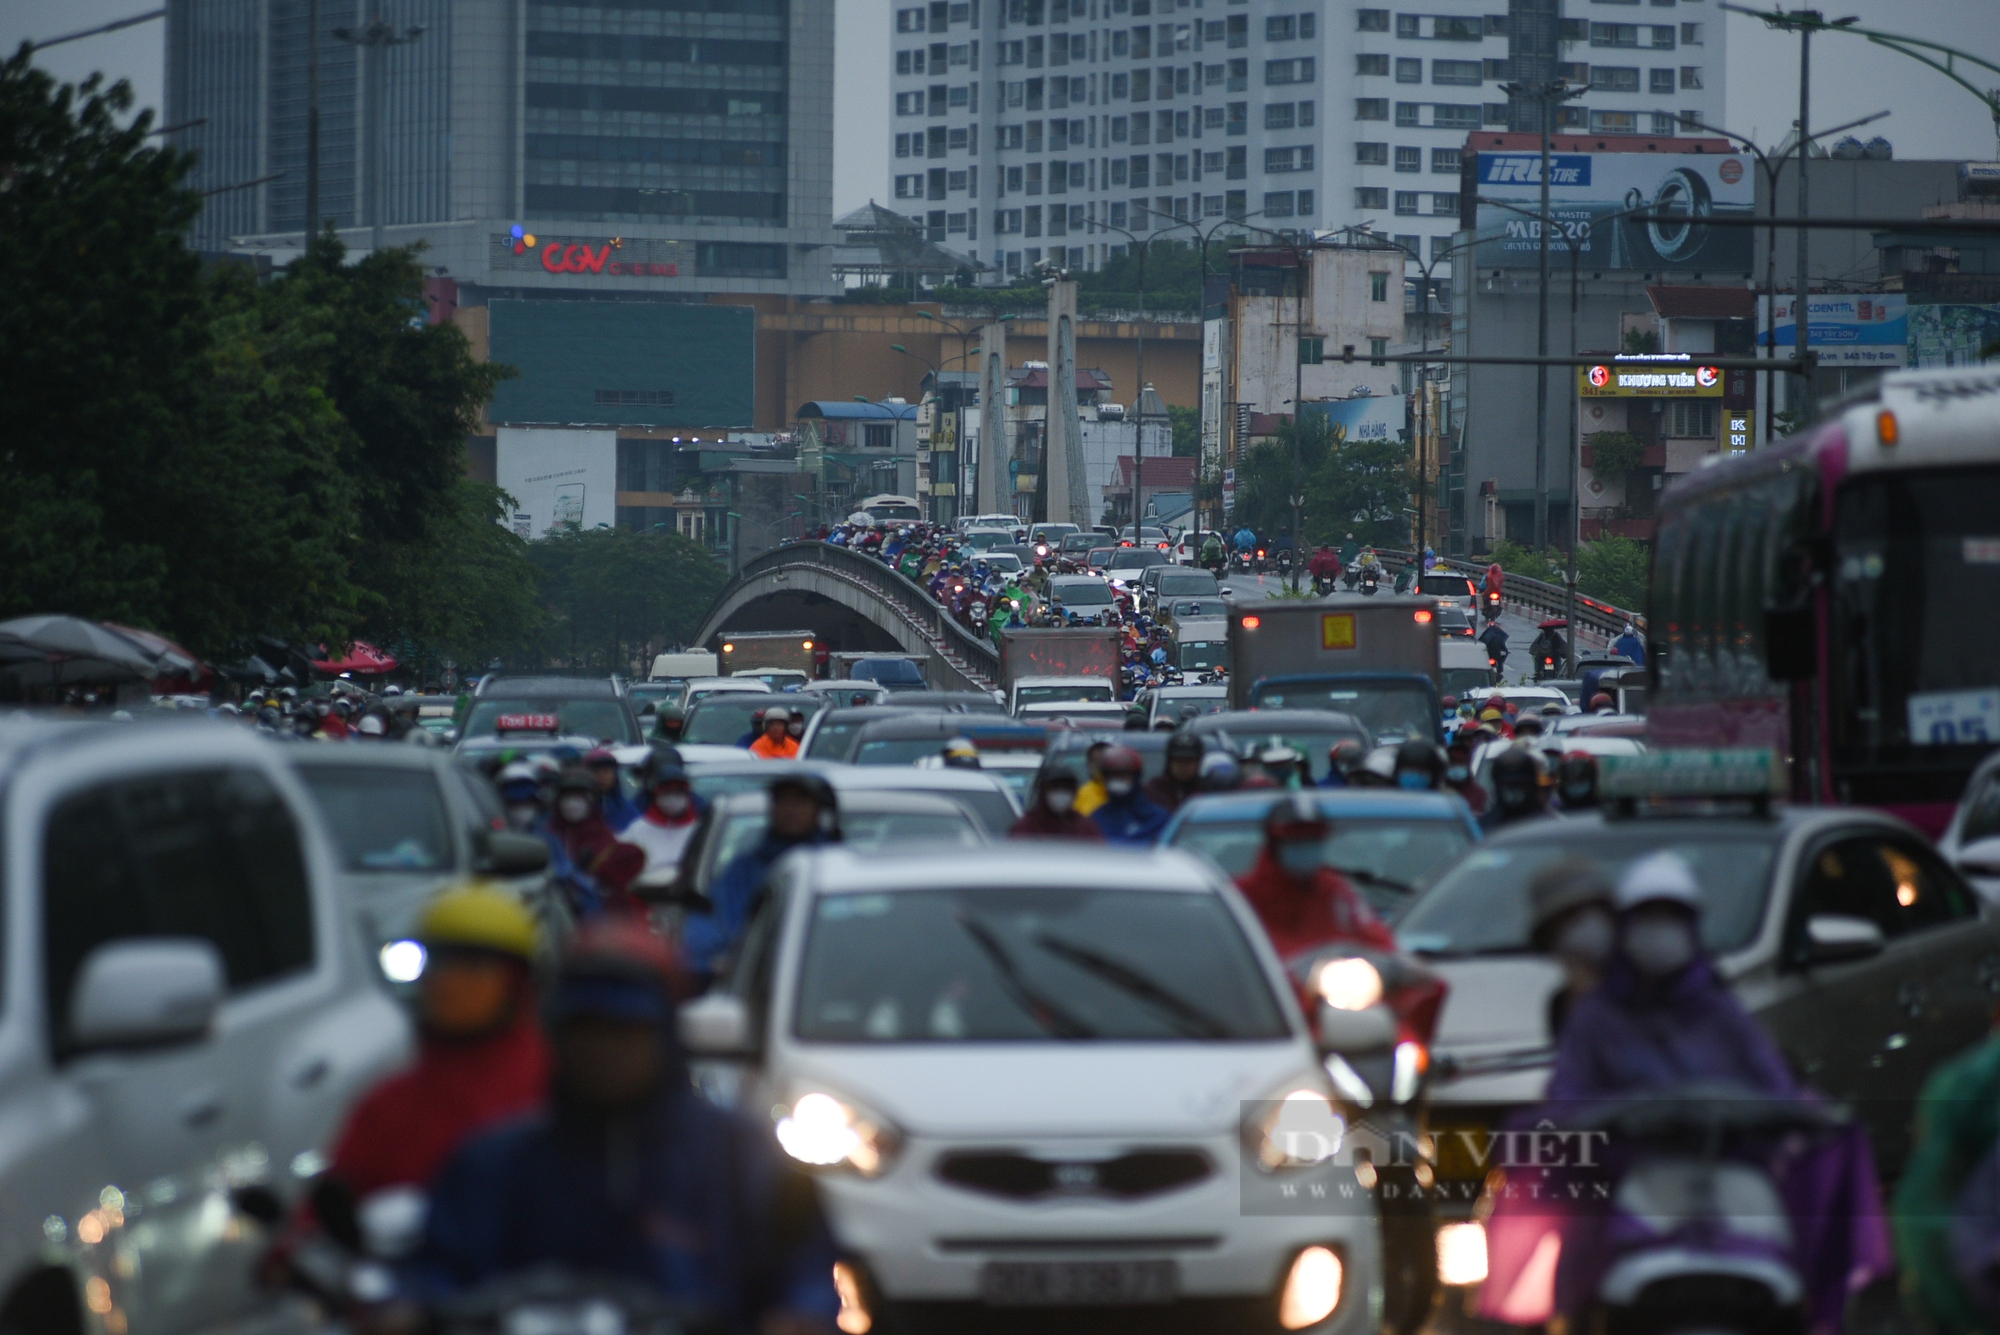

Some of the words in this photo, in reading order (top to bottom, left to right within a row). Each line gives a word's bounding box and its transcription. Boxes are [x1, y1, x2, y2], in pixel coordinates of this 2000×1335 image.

[1552, 168, 1581, 183] TIRE
[1557, 211, 1591, 219] MASTER
[541, 242, 612, 274] CGV
[1824, 329, 1837, 338] TÂY
[1862, 351, 1877, 361] Tây
[1582, 386, 1598, 395] 341
[1359, 420, 1370, 438] NHÀ
[1371, 420, 1387, 438] HÀNG
